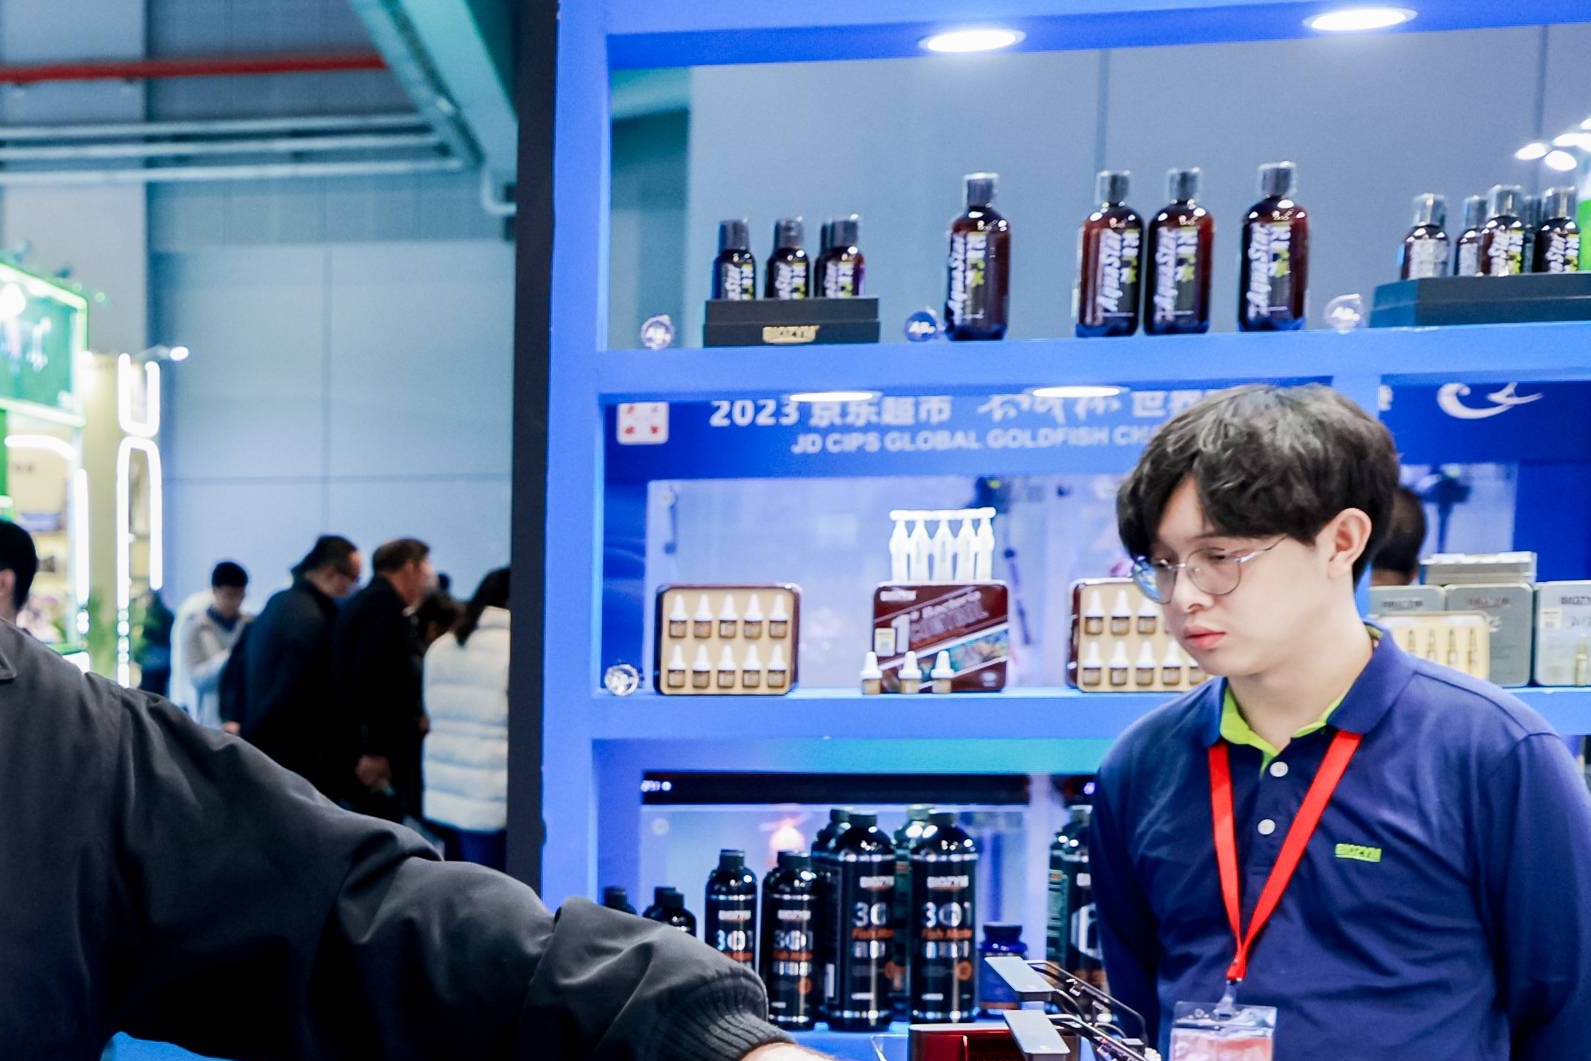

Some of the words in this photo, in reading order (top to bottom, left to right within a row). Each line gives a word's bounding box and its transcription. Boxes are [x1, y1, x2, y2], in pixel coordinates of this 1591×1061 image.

[709, 399, 800, 427] 2023
[790, 433, 822, 455] JD
[825, 432, 881, 454] CIPS
[883, 429, 984, 452] GLOBAL
[986, 426, 1110, 448] GOLDFISH
